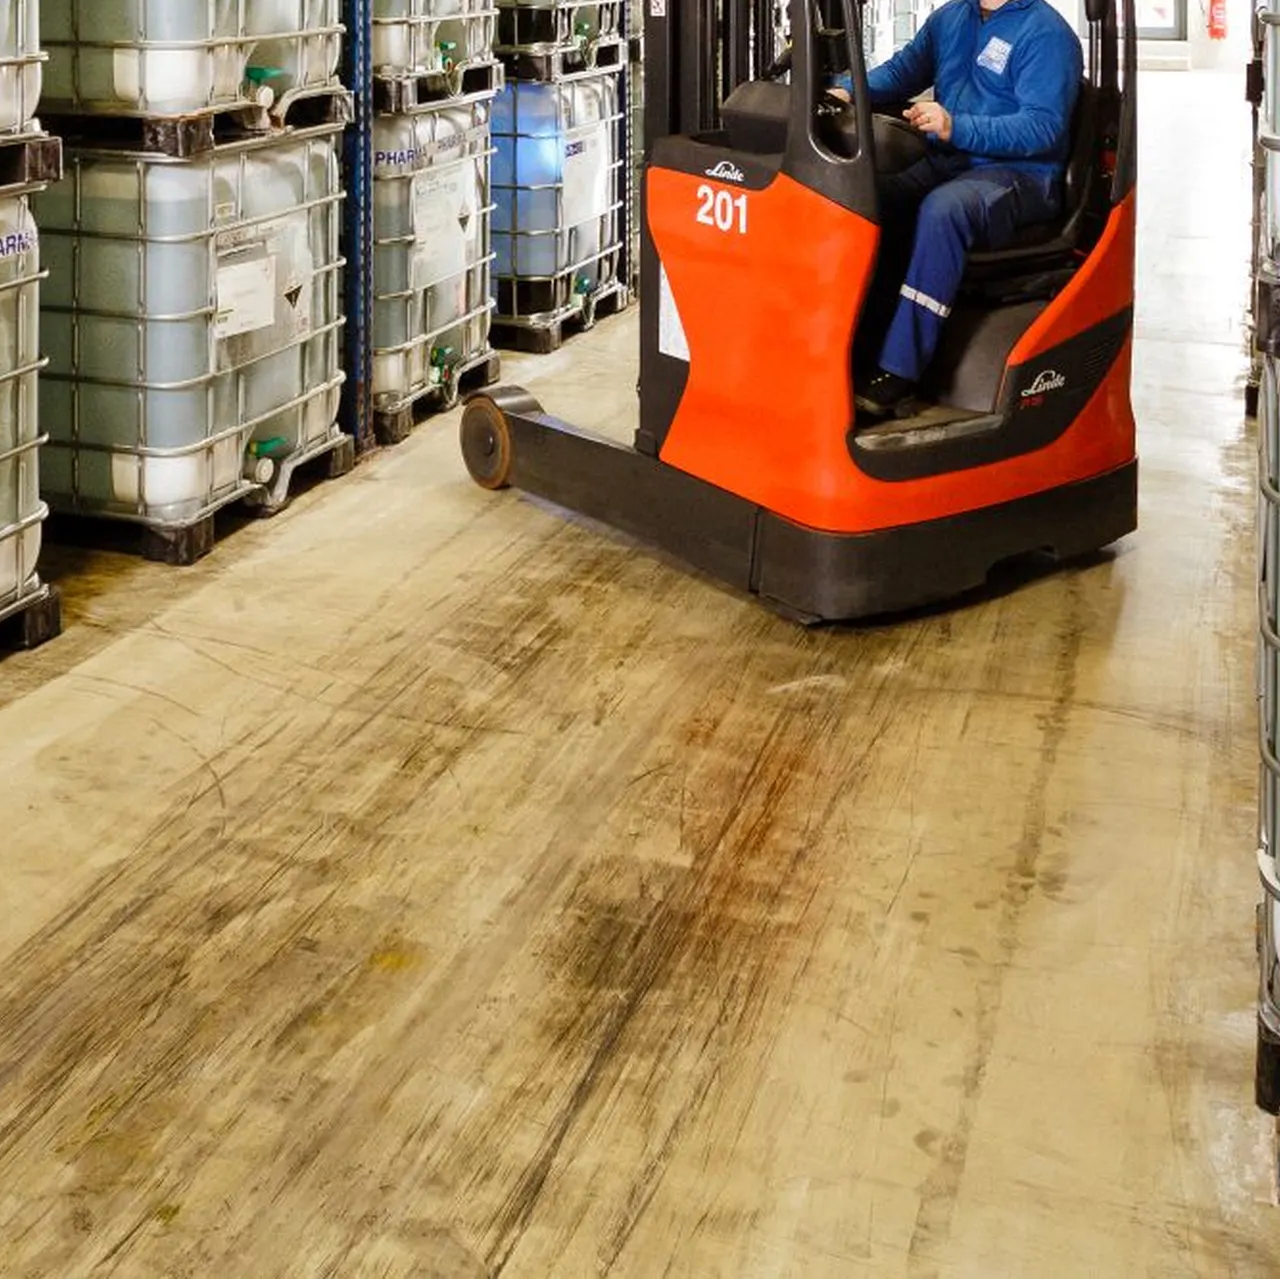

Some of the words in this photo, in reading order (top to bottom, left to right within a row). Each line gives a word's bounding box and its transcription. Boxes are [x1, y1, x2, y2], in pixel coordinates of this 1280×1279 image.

[704, 160, 745, 182] Linde
[696, 184, 748, 234] 201
[1020, 369, 1066, 397] Linde
